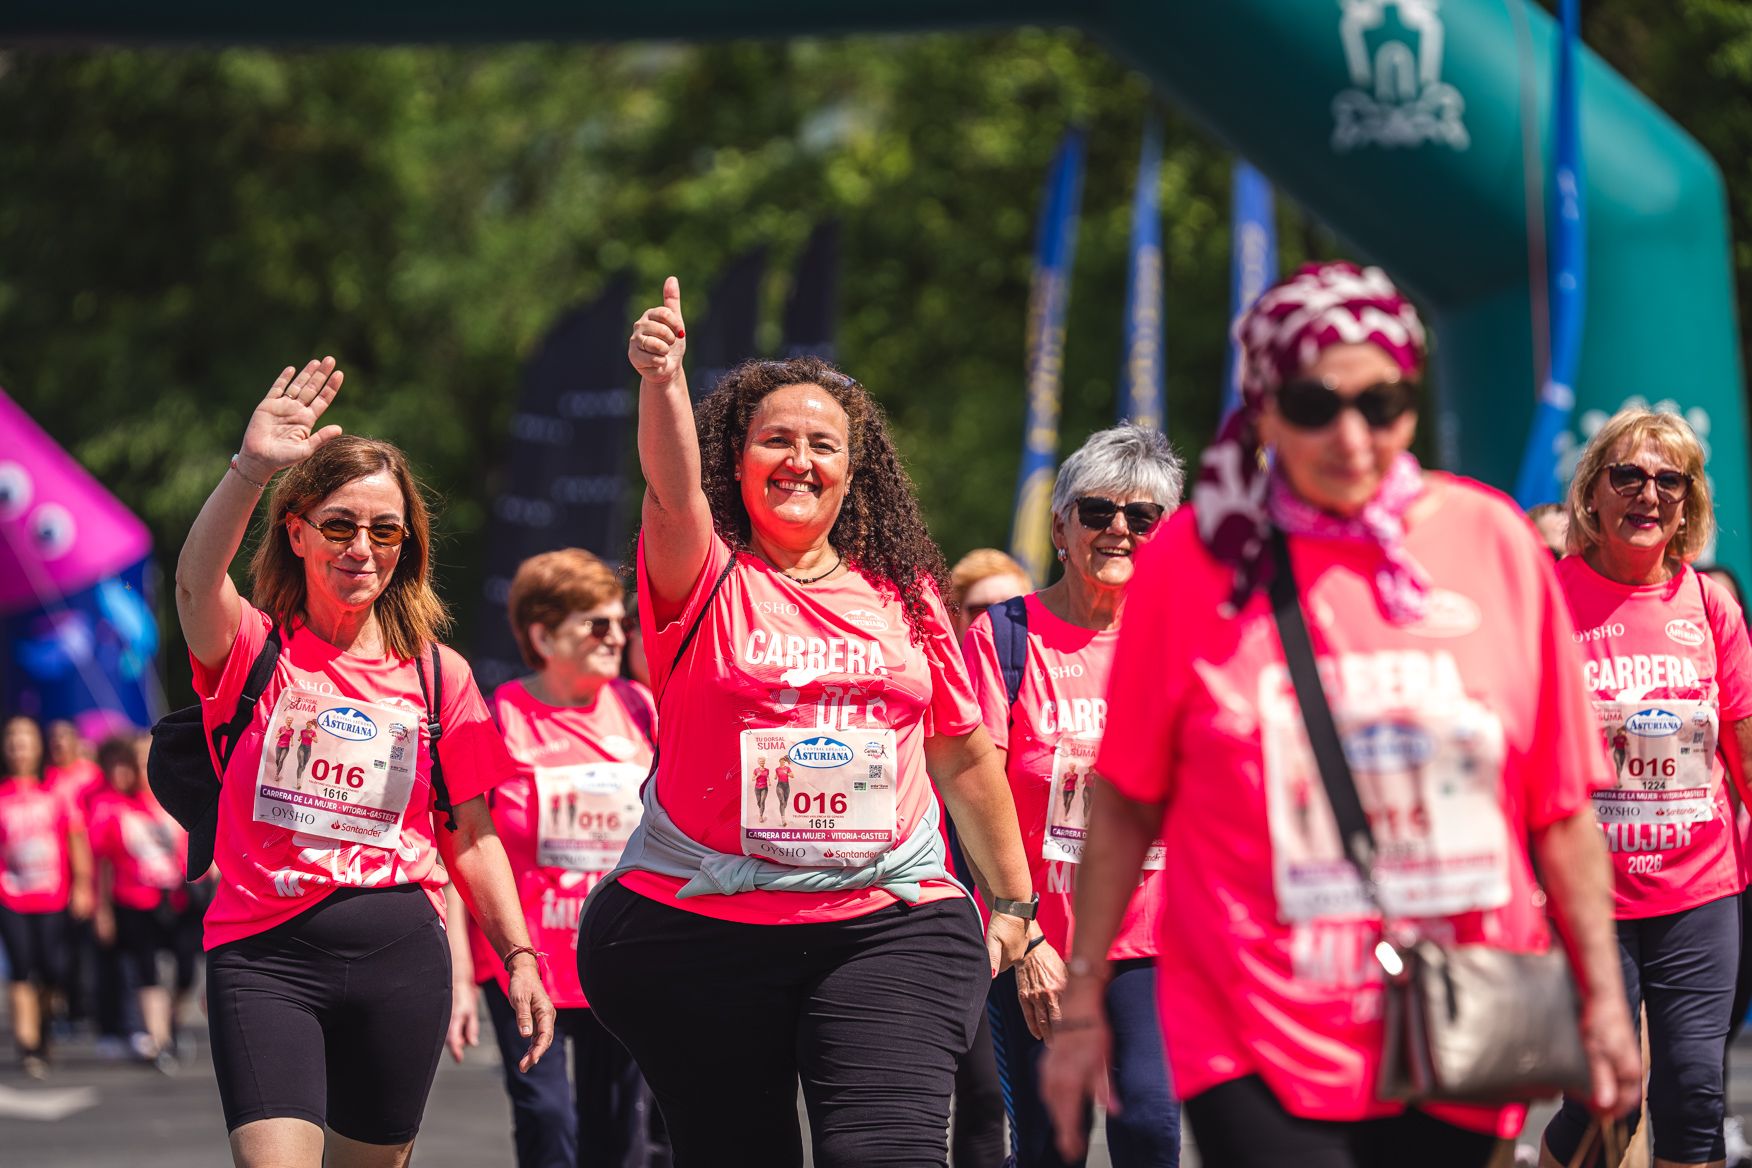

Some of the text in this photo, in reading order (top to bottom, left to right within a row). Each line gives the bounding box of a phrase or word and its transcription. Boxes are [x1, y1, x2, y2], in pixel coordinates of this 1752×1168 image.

[750, 601, 800, 617] YSHO
[1571, 623, 1625, 643] OYSHO
[744, 628, 888, 676] CARRERA
[1034, 664, 1084, 682] OSHO
[1583, 654, 1701, 692] CARRERA
[1039, 698, 1109, 735] CARR
[321, 714, 373, 737] ASTURIANA
[1630, 719, 1679, 731] ASTURIANA
[757, 742, 786, 751] SUMA
[793, 748, 849, 761] ASTURIANA
[1070, 748, 1096, 758] SUMA
[311, 758, 365, 789] 016
[1628, 757, 1676, 777] 016
[1642, 781, 1666, 790] 1224
[322, 787, 348, 801] 1616
[1617, 792, 1626, 800] DE
[1627, 792, 1636, 800] LA
[1636, 792, 1658, 800] MUJER
[262, 788, 397, 823] CARRERA DE LA MUJER VITORIA-GASTEIZ
[793, 792, 848, 814] 016
[1598, 806, 1641, 816] OYSHO
[271, 806, 381, 838] OYSHO Santander
[578, 812, 621, 829] 016
[808, 819, 835, 829] 1615
[748, 831, 889, 840] CARRERA DE LA MUJER VITORIA-GASTEIZ
[1052, 828, 1081, 839] CARRERA
[760, 843, 878, 859] OYSHO Santander
[1627, 854, 1663, 875] 2026
